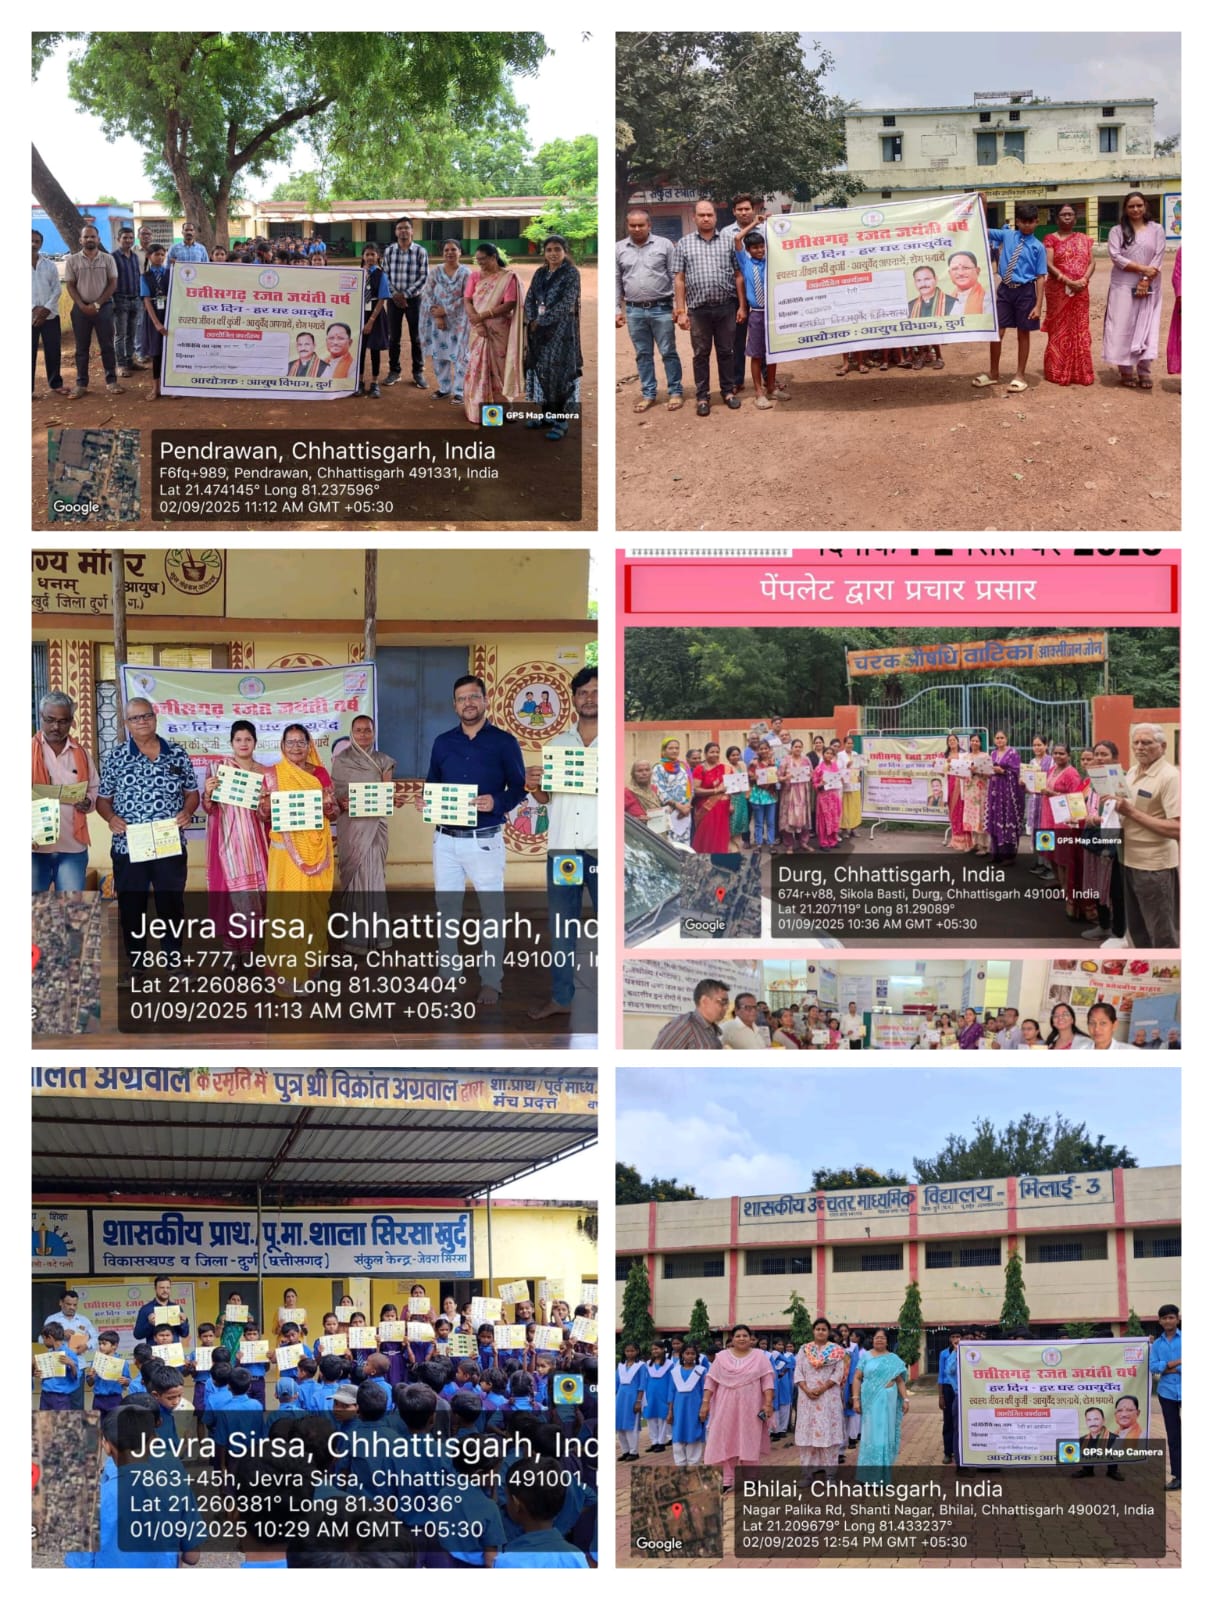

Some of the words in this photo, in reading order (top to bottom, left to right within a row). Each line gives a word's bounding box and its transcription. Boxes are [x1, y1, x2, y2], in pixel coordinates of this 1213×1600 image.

[857, 228, 891, 242] रजत
[896, 222, 941, 237] जयंती
[947, 219, 968, 233] वर्ष
[800, 253, 819, 262] हर
[822, 249, 846, 259] दिन
[859, 246, 874, 256] हर
[880, 244, 899, 252] घर
[186, 286, 246, 303] छत्तीसगढ़
[252, 290, 283, 302] रजत
[287, 290, 326, 303] जयंती
[330, 293, 350, 304] वर्ष
[202, 304, 219, 312] हर
[221, 304, 242, 314] दिन
[292, 308, 333, 318] आयुर्वेद
[798, 331, 851, 344] आयोजक
[861, 324, 897, 335] आयुष
[945, 317, 964, 330] दुर्ग
[191, 377, 238, 385] आयोजक
[247, 378, 276, 388] आयुष
[316, 380, 332, 389] दुर्ग
[38, 578, 79, 594] धनम्
[57, 596, 85, 609] जिला
[90, 594, 107, 613] दुर्ग
[854, 656, 900, 670] चरक
[964, 642, 1034, 662] वाटिका
[232, 702, 271, 715] रजत
[277, 699, 328, 715] जयंती
[334, 696, 359, 713] वर्ष
[168, 723, 190, 733] हर
[192, 723, 220, 732] दिन
[273, 1073, 304, 1102] पुत्र
[307, 1068, 328, 1096] श्री
[331, 1070, 390, 1100] विक्रांत
[392, 1077, 458, 1101] अग्रवाल
[493, 1095, 518, 1108] मंच
[523, 1096, 557, 1109] प्रदत्त
[743, 1195, 804, 1217] शासकीय
[857, 1189, 914, 1211] माध्यमिक
[924, 1185, 994, 1205] विद्यालय
[103, 1212, 203, 1246] शासकीय
[371, 1215, 434, 1245] सिरसा
[435, 1214, 467, 1253] खुर्द
[103, 1253, 175, 1267] विकासखण्ड
[180, 1257, 190, 1266] व
[354, 1253, 383, 1269] संकुल
[441, 1252, 467, 1264] सिरसा
[973, 1368, 1031, 1381] छत्तीसगढ़
[1037, 1370, 1068, 1379] रजत
[1072, 1366, 1112, 1378] जयंती
[1117, 1366, 1137, 1377] वर्ष
[989, 1384, 1006, 1392] हर
[1007, 1384, 1028, 1392] दिन
[1078, 1383, 1120, 1392] आयुर्वेद
